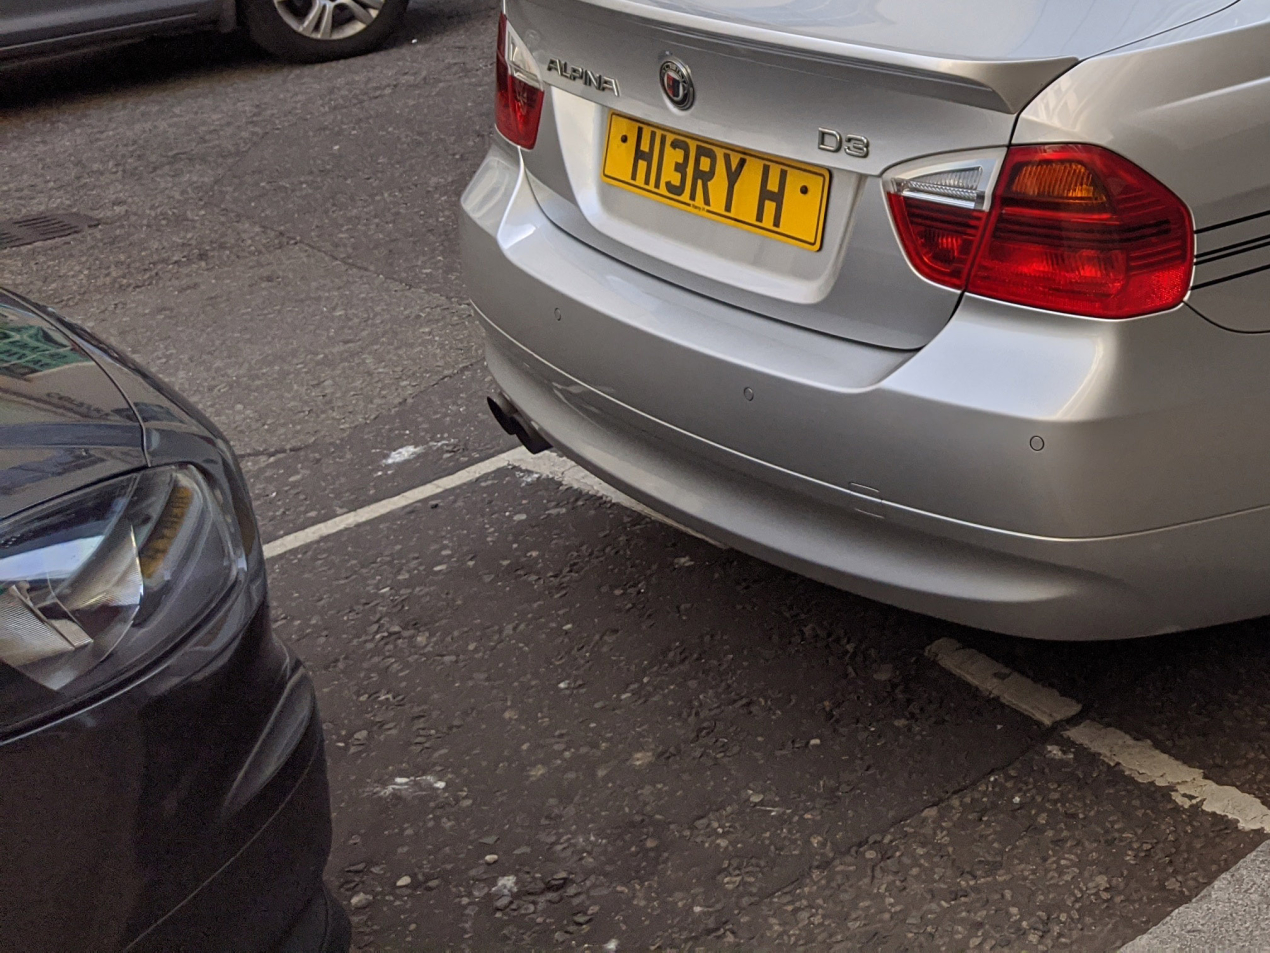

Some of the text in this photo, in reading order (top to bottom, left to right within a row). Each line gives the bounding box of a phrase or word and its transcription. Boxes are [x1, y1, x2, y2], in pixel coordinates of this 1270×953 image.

[547, 59, 620, 97] ALPINA
[817, 127, 870, 159] D3
[755, 163, 788, 228] H
